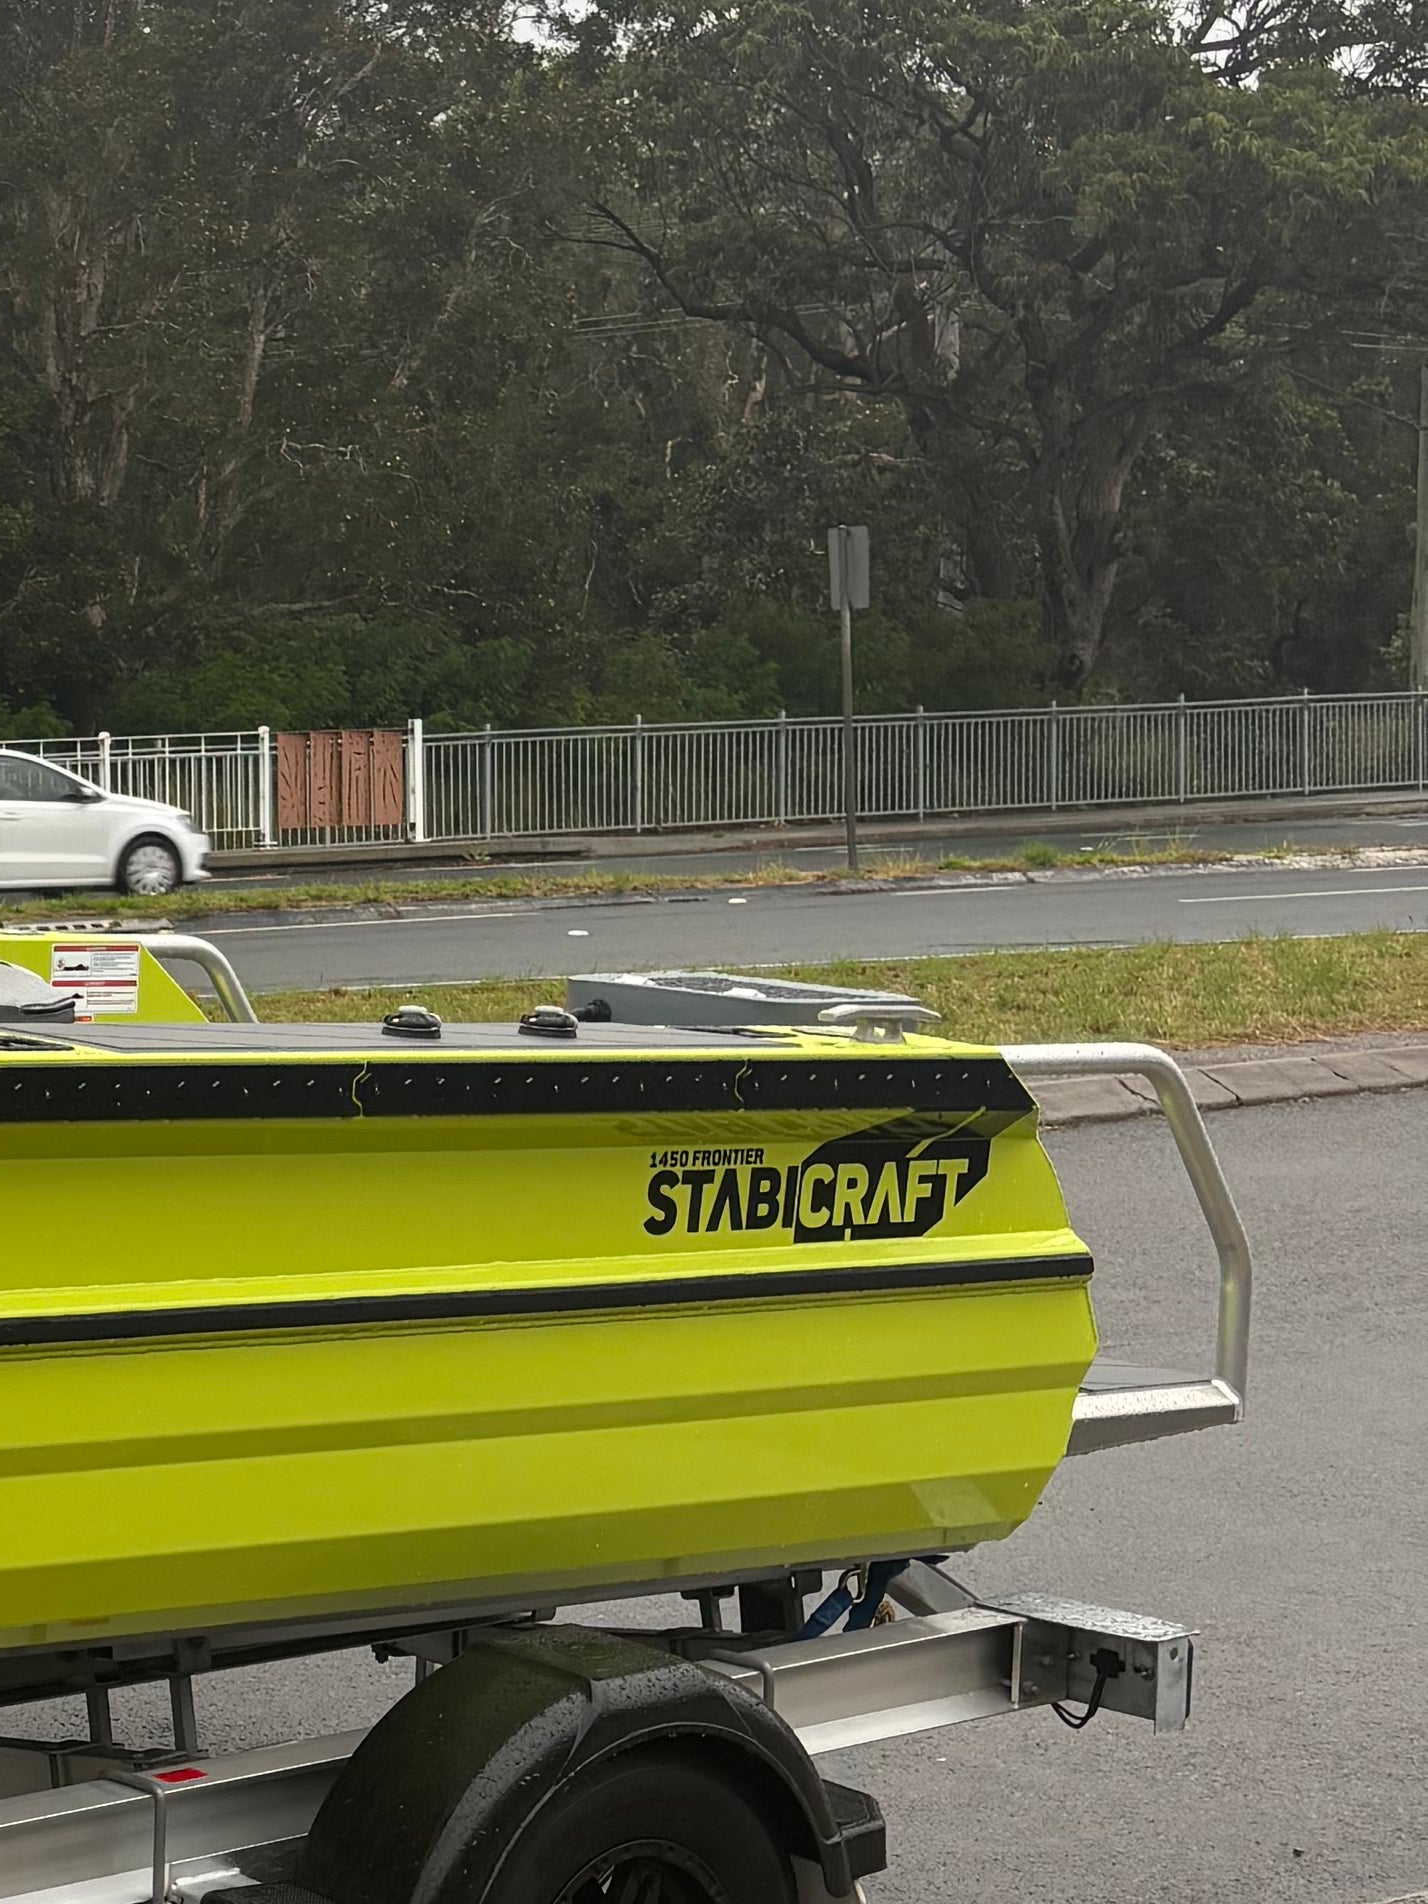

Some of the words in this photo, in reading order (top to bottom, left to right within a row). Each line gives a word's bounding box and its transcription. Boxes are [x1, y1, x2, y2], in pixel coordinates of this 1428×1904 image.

[649, 1151, 689, 1168] 1450
[691, 1148, 765, 1167] FRONTIER
[643, 1158, 969, 1236] STABICRAFT
